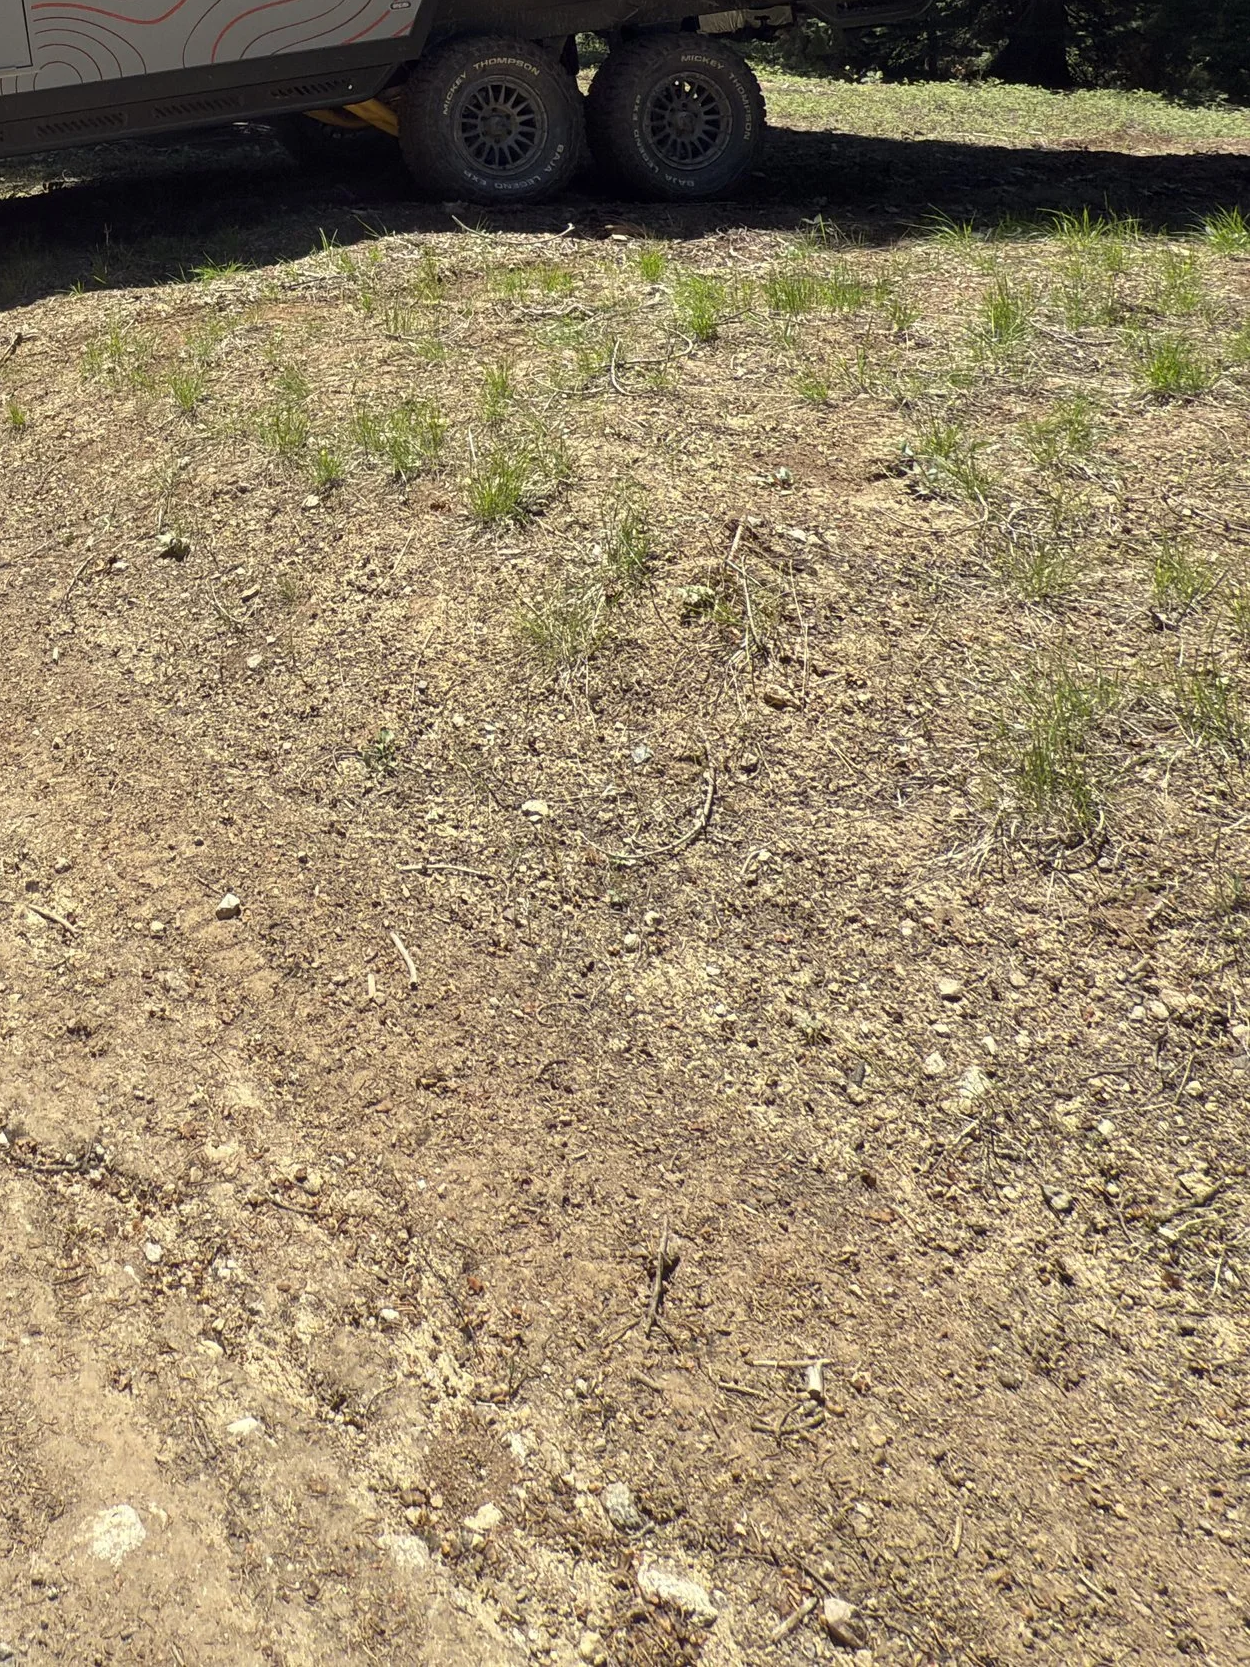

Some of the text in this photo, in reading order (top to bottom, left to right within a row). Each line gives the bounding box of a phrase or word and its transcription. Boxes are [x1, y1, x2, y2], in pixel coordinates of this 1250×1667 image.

[442, 57, 541, 116] MICKEY THOMPSON
[680, 54, 752, 141] MICKEY THOMPSON
[463, 144, 565, 190] BAJA LEGEND EXP
[632, 129, 660, 174] LEGEND
[665, 173, 695, 188] BAJA
